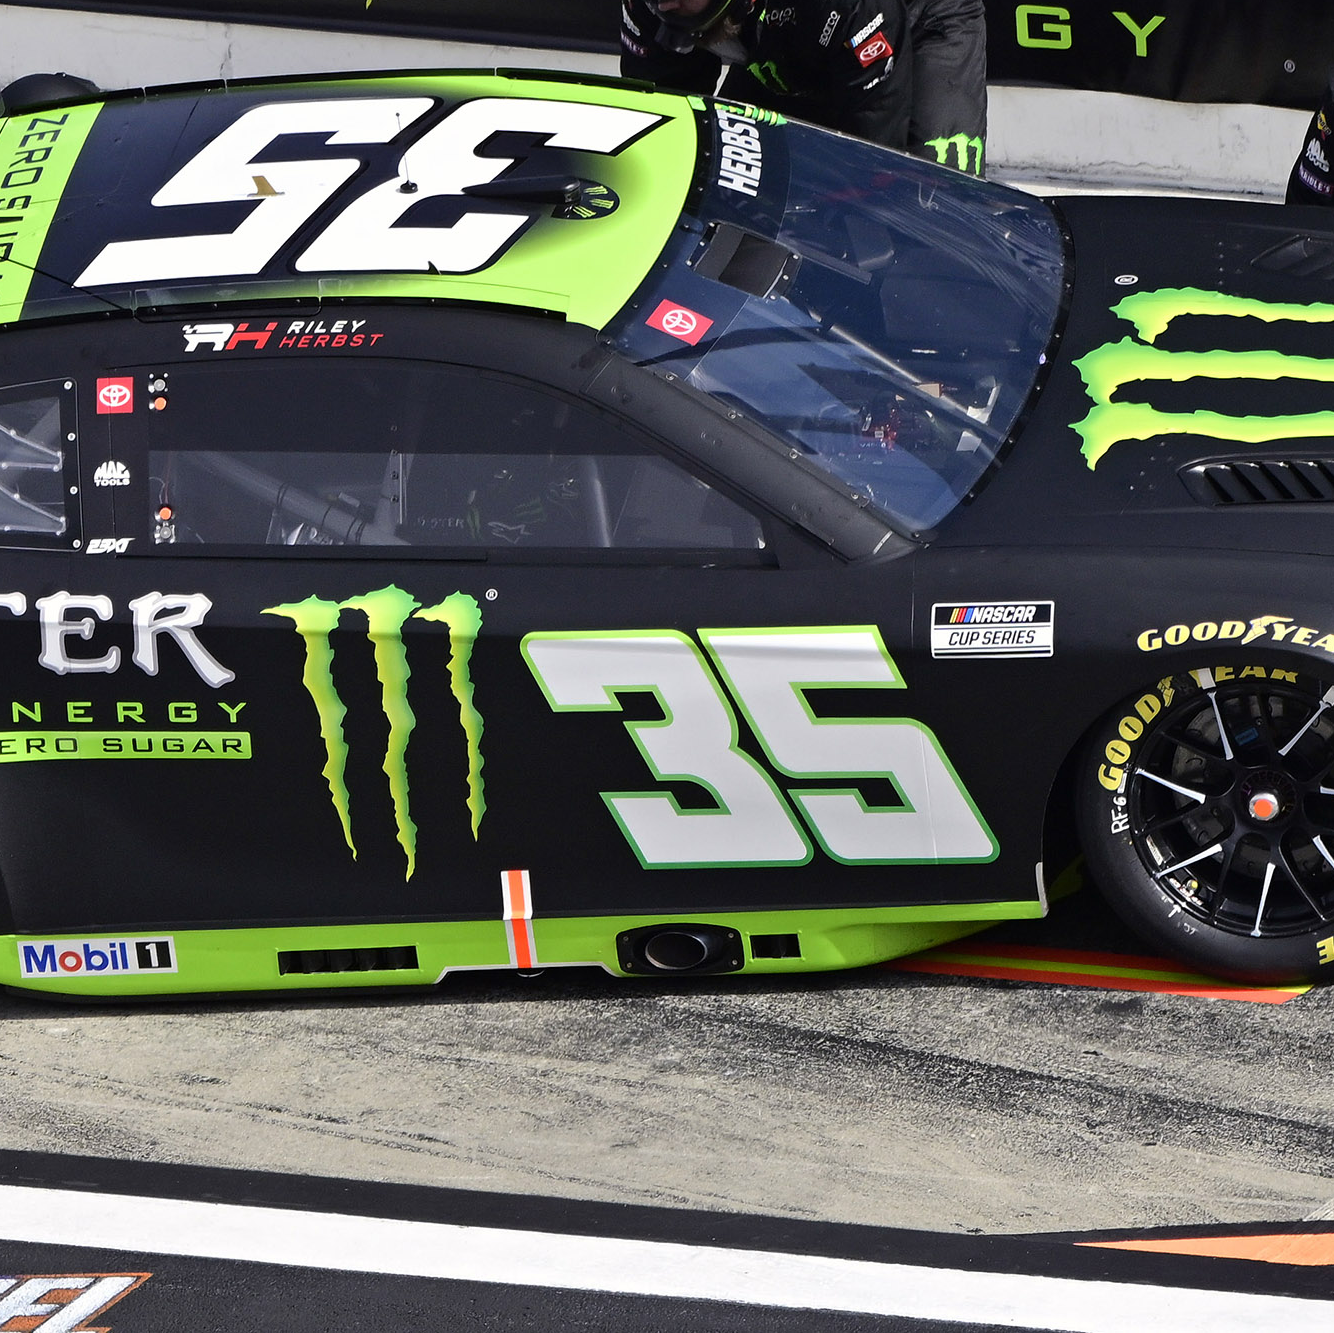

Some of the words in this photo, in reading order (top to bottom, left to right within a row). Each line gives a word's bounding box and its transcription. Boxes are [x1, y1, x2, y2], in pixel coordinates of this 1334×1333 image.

[817, 11, 842, 47] sparco
[851, 12, 885, 46] NASCAR
[1, 113, 68, 189] ZERO
[718, 110, 761, 197] HERBST
[71, 97, 667, 288] 35
[278, 333, 385, 349] HERBST
[287, 319, 366, 334] RILEY
[94, 460, 131, 480] MAC
[95, 477, 131, 487] TOOLS
[85, 537, 137, 555] 23XI
[970, 605, 1036, 624] NASCAR
[948, 631, 979, 647] CUP
[983, 629, 1037, 647] SERIES
[102, 735, 245, 757] SUGAR
[1098, 666, 1299, 792] GOODYEAR
[520, 624, 1000, 870] 35
[1111, 796, 1129, 834] RF-6
[24, 940, 129, 974] Mobil
[143, 941, 162, 968] 1
